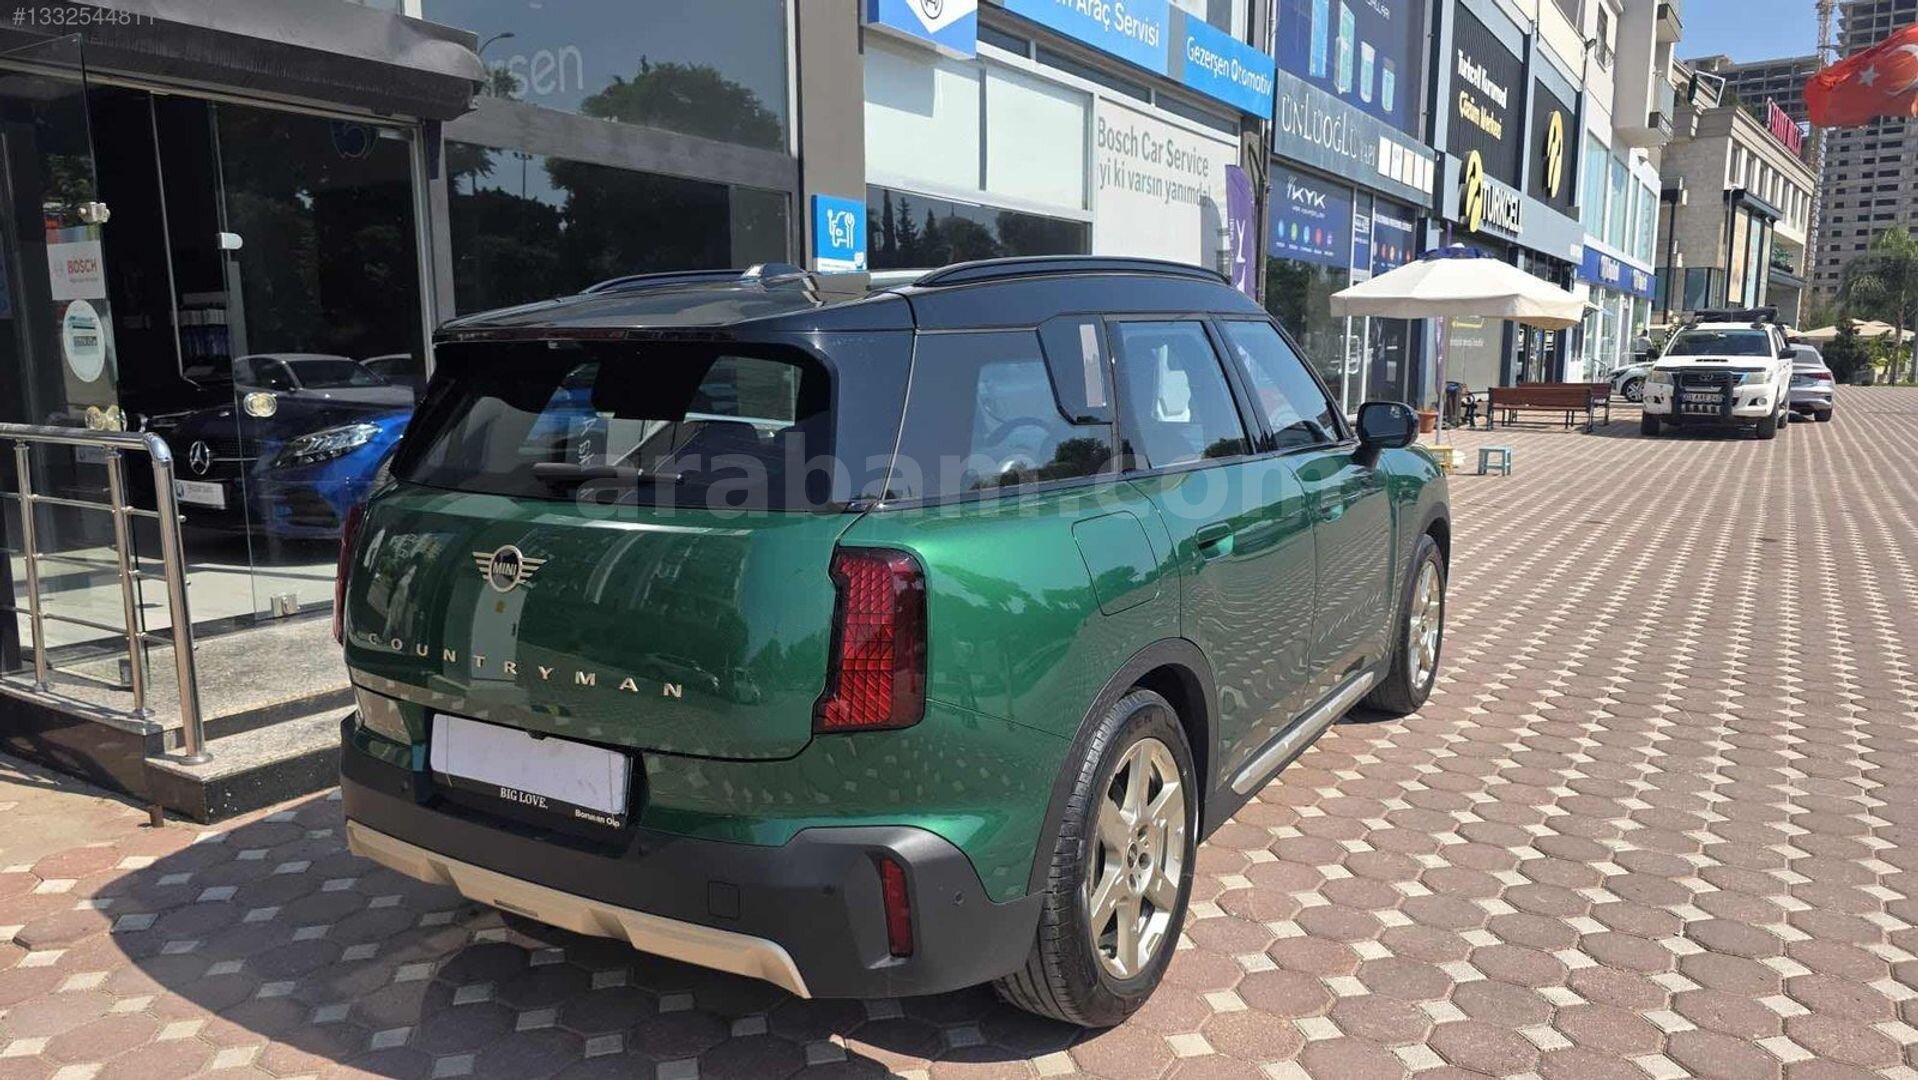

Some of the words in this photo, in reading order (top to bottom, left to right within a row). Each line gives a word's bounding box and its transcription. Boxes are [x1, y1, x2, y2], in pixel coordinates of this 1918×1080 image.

[1115, 3, 1160, 47] Servisi
[1097, 116, 1139, 158] Bosch
[1142, 131, 1165, 167] Car
[1166, 138, 1209, 178] Service
[1114, 159, 1126, 190] ki
[66, 257, 98, 274] BOSCH
[492, 562, 518, 577] MINI
[367, 632, 684, 699] COUNTRYMAN
[500, 786, 518, 801] BIG
[518, 790, 549, 809] LOVE.
